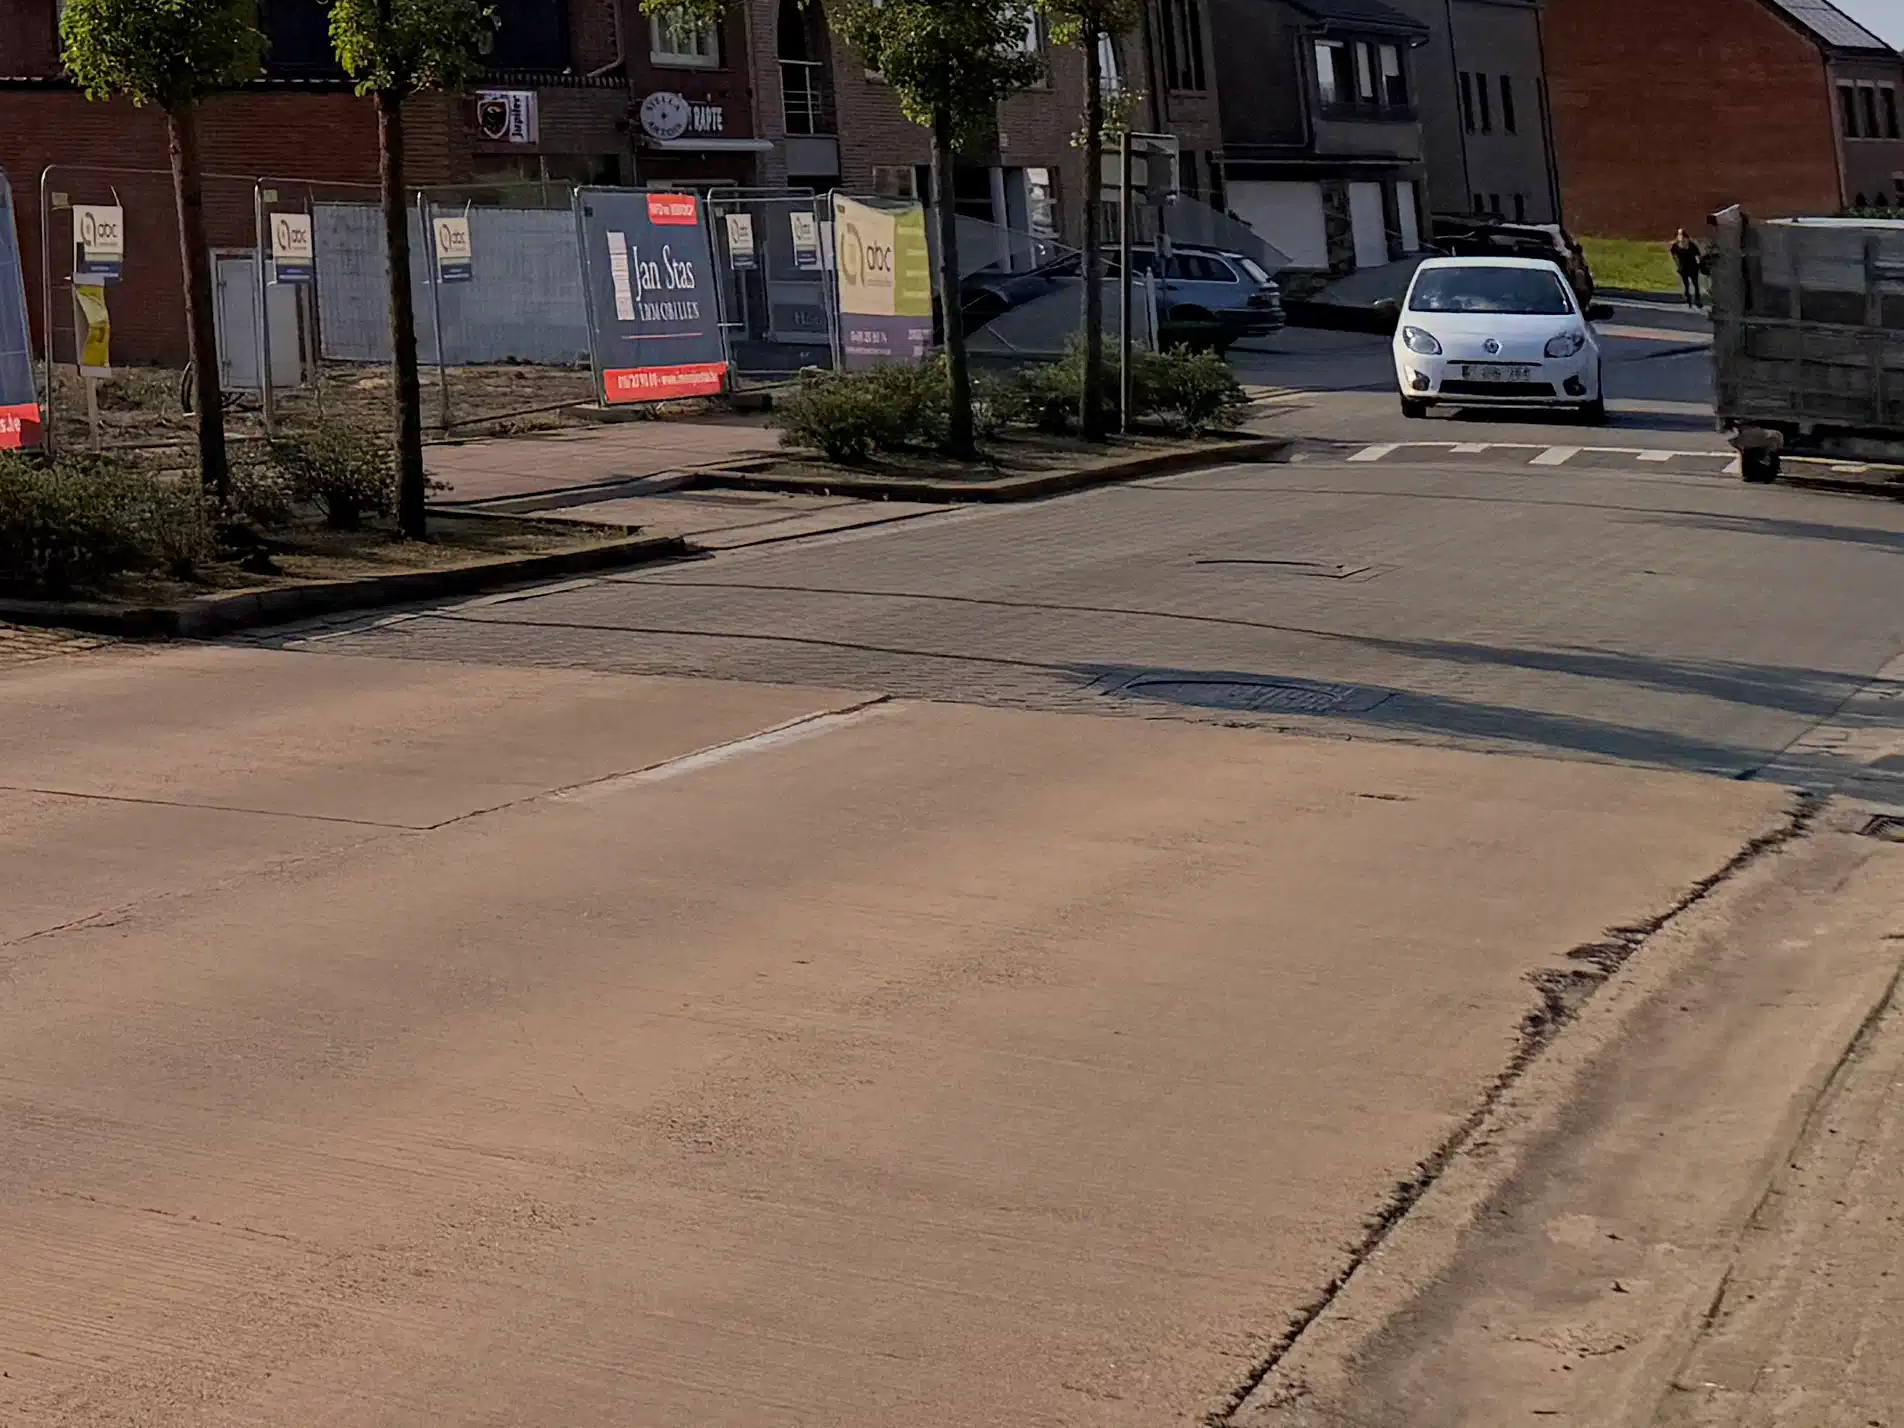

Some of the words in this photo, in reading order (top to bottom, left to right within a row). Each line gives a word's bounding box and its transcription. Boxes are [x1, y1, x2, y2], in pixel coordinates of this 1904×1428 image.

[97, 220, 117, 238] abc
[866, 239, 891, 272] abc
[632, 246, 662, 301] Jan
[663, 245, 696, 290] Stas
